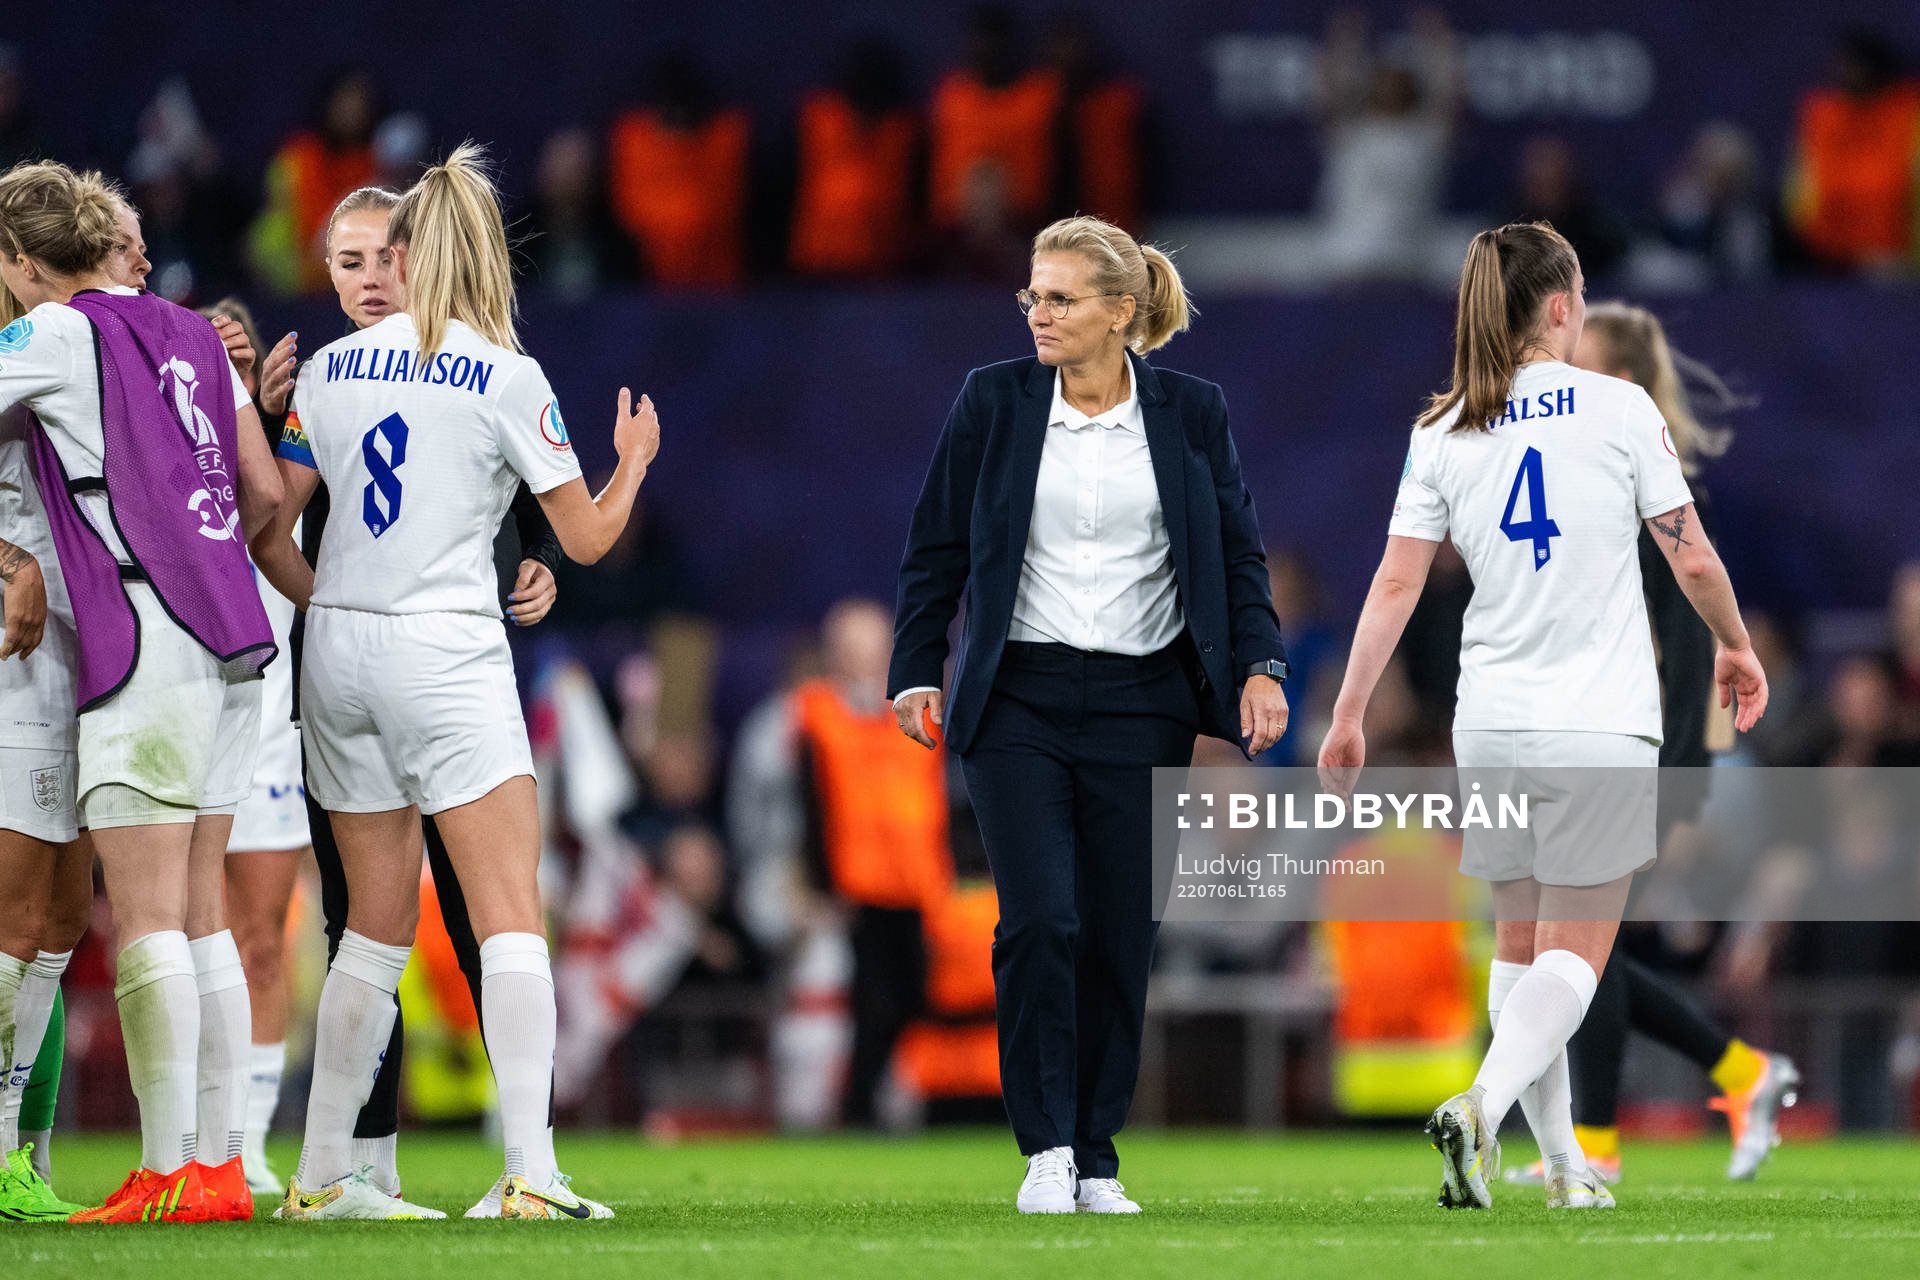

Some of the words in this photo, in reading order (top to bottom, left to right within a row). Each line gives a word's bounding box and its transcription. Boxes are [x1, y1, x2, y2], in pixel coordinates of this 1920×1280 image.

[327, 348, 494, 395] WILLIAMSON
[1489, 387, 1575, 430] ALSH
[362, 411, 409, 540] 8
[1499, 446, 1562, 573] 4
